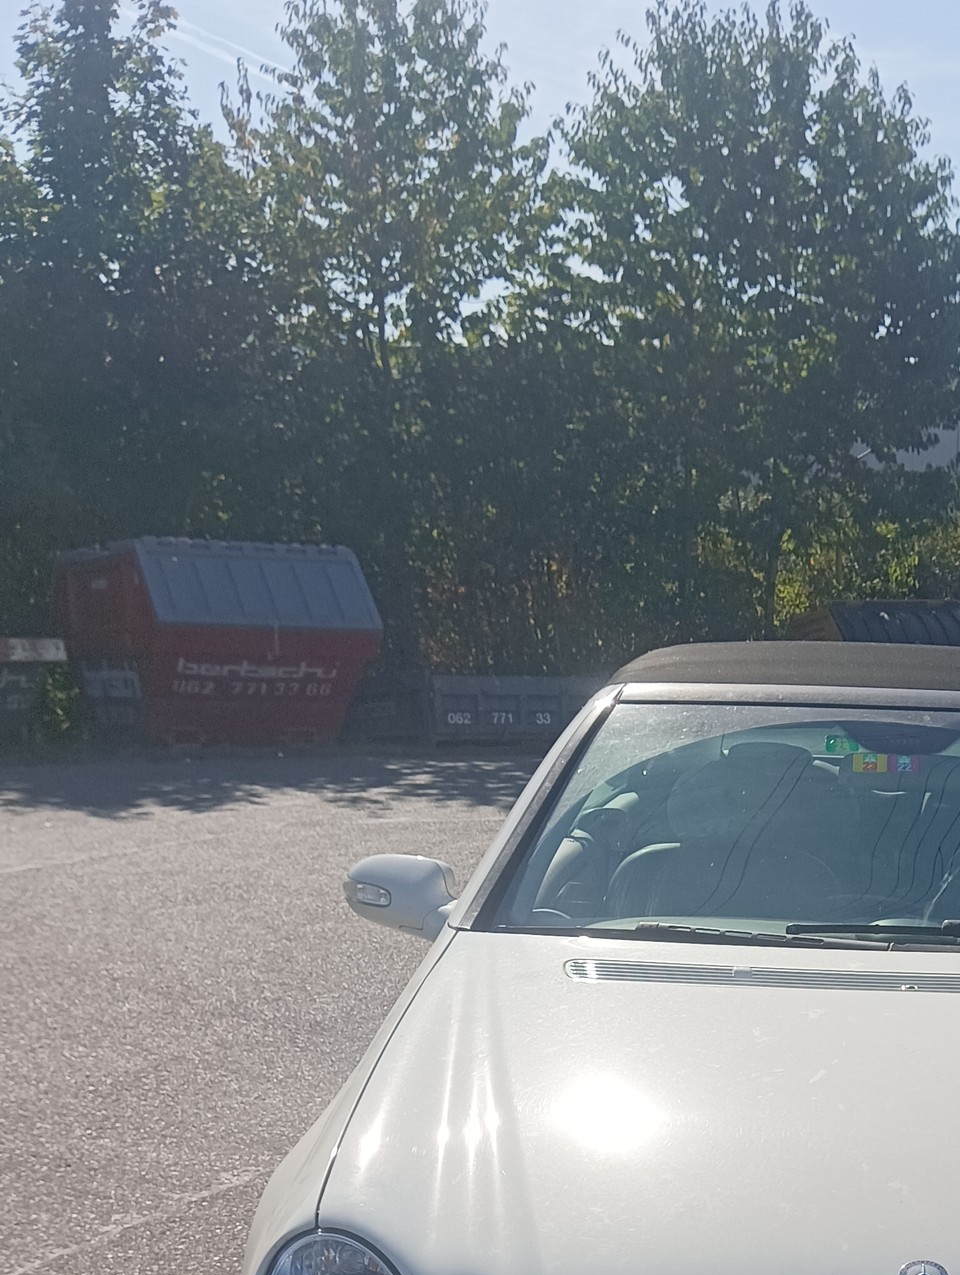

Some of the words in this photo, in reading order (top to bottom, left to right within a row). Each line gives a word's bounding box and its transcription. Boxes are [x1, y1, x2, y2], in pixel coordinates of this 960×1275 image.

[172, 680, 215, 695] 062
[231, 682, 267, 695] 771
[272, 682, 300, 696] 33
[305, 682, 331, 697] 66
[447, 712, 472, 725] 062
[491, 712, 514, 724] 771
[535, 713, 551, 725] 33
[897, 763, 912, 772] 22
